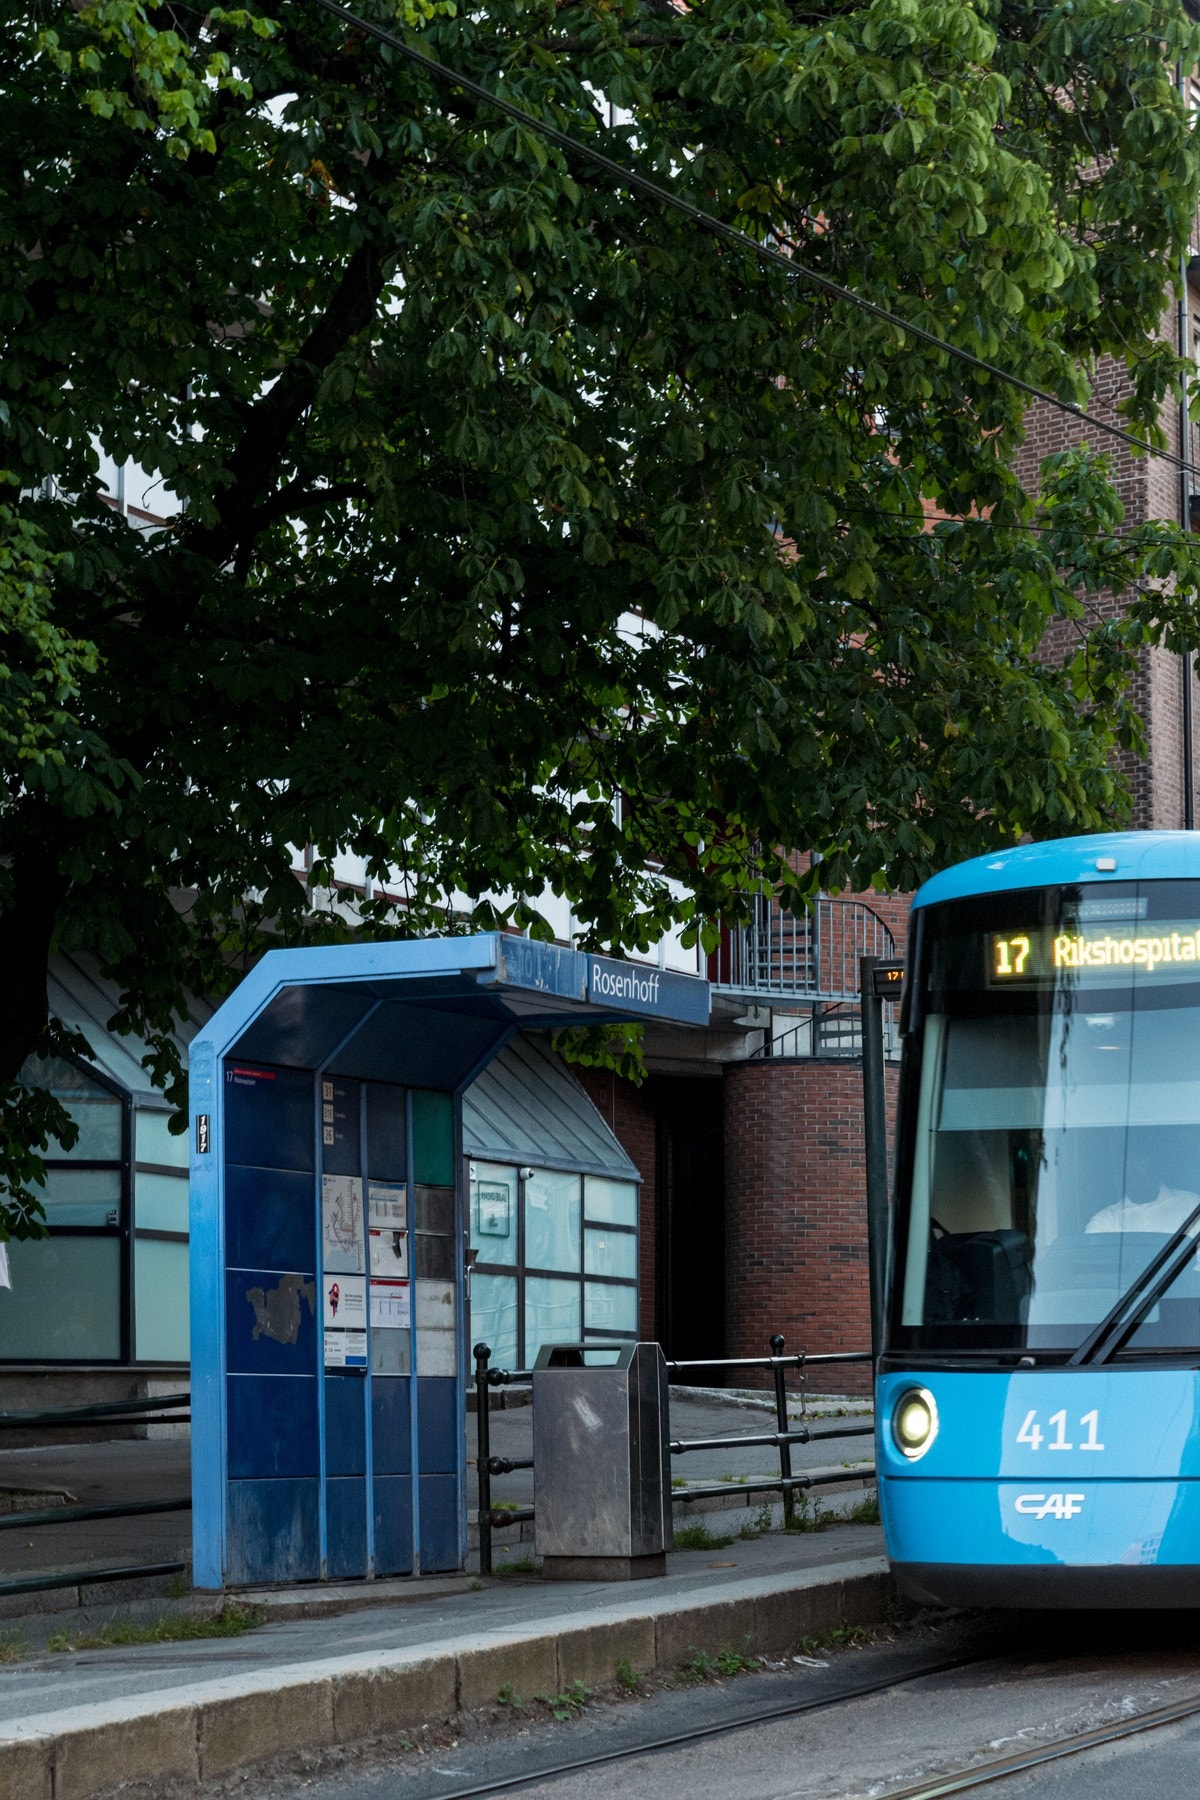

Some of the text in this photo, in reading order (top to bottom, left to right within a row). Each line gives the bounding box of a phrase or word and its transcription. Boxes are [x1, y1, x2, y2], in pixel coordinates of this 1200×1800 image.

[996, 936, 1030, 974] 17
[593, 963, 660, 1004] Rosenhoff
[887, 971, 899, 981] 17
[226, 1070, 234, 1083] 17
[199, 1115, 208, 1153] 1917
[1016, 1409, 1105, 1451] 411
[1014, 1493, 1085, 1520] CAF
